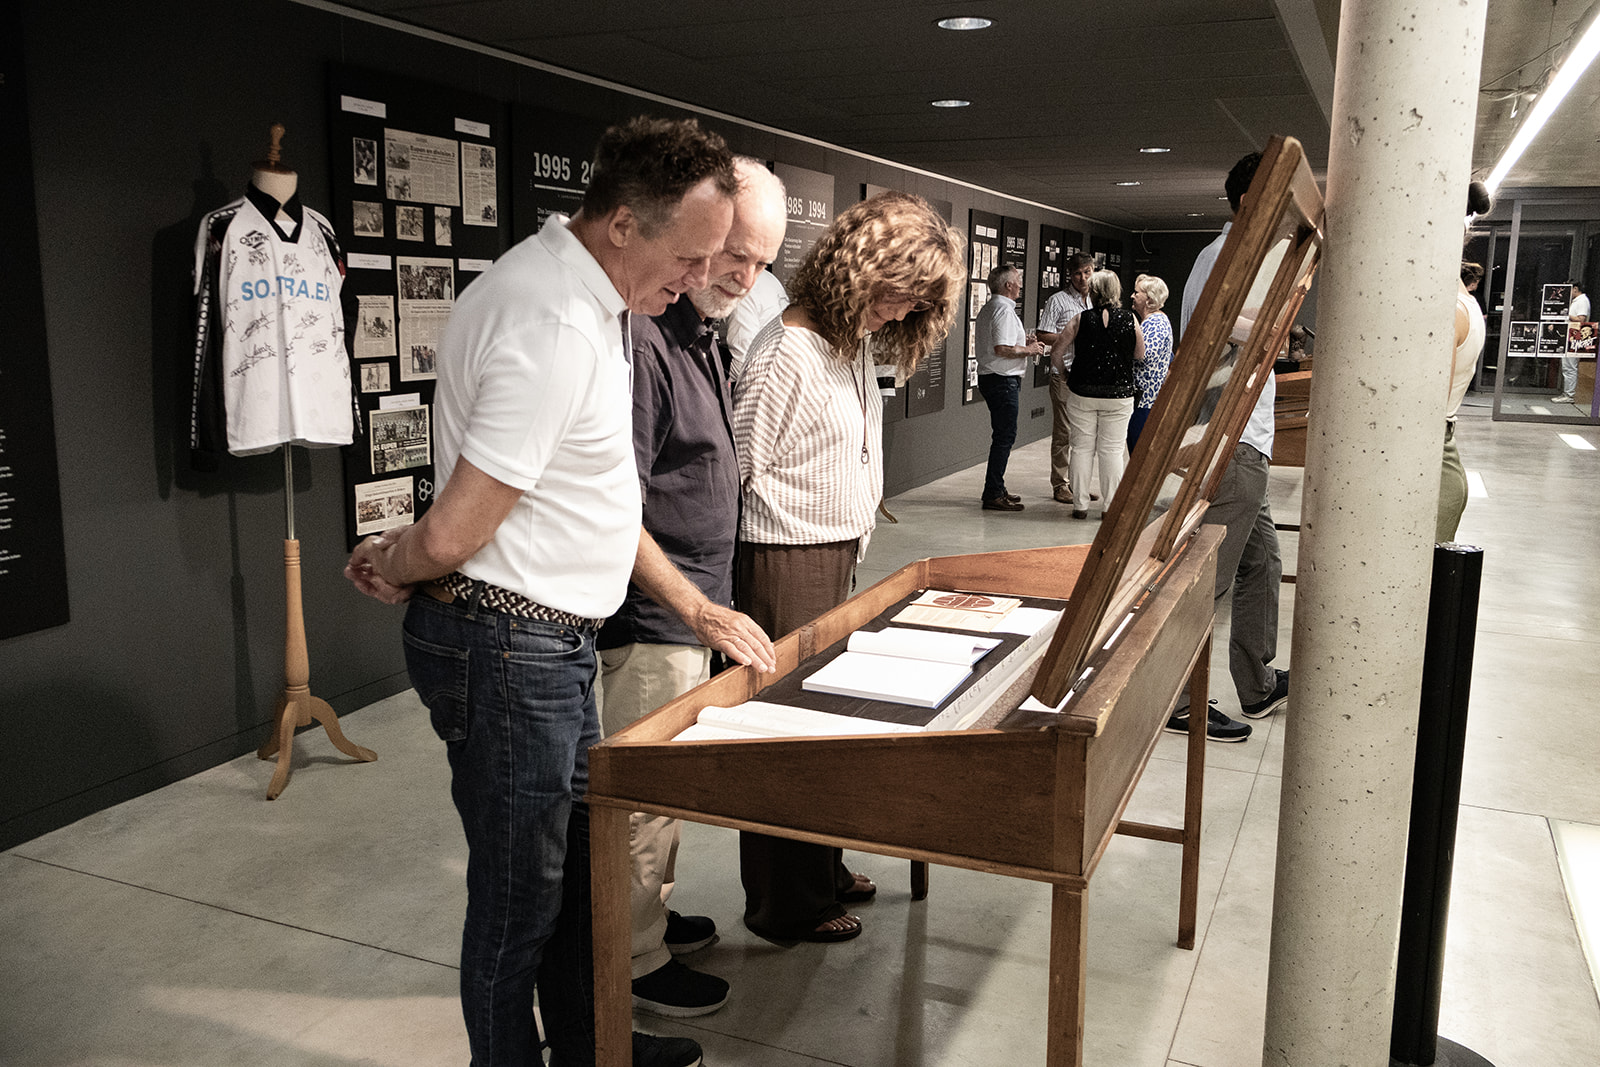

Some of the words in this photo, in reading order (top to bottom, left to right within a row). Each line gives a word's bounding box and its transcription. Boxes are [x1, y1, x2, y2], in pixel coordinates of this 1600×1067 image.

[533, 152, 571, 182] 1995
[785, 196, 803, 216] 985
[808, 200, 826, 219] 1994
[241, 275, 332, 303] SO.TRA.EX
